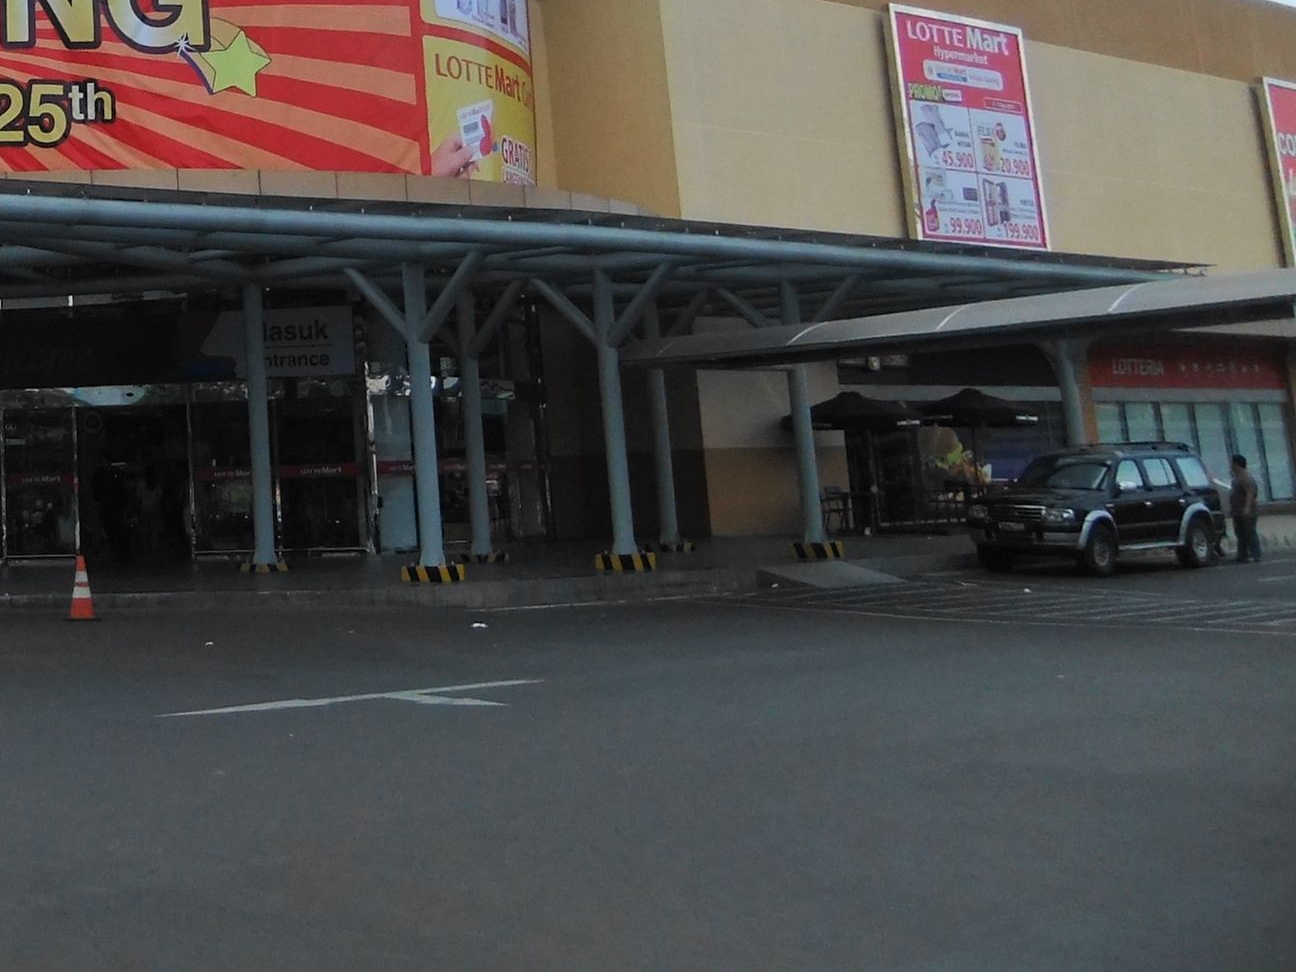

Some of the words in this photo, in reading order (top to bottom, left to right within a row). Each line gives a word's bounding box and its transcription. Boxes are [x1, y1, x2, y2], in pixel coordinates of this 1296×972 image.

[906, 20, 963, 48] LOTTE
[966, 26, 1009, 56] Mart
[1112, 358, 1164, 376] LOTTERIA
